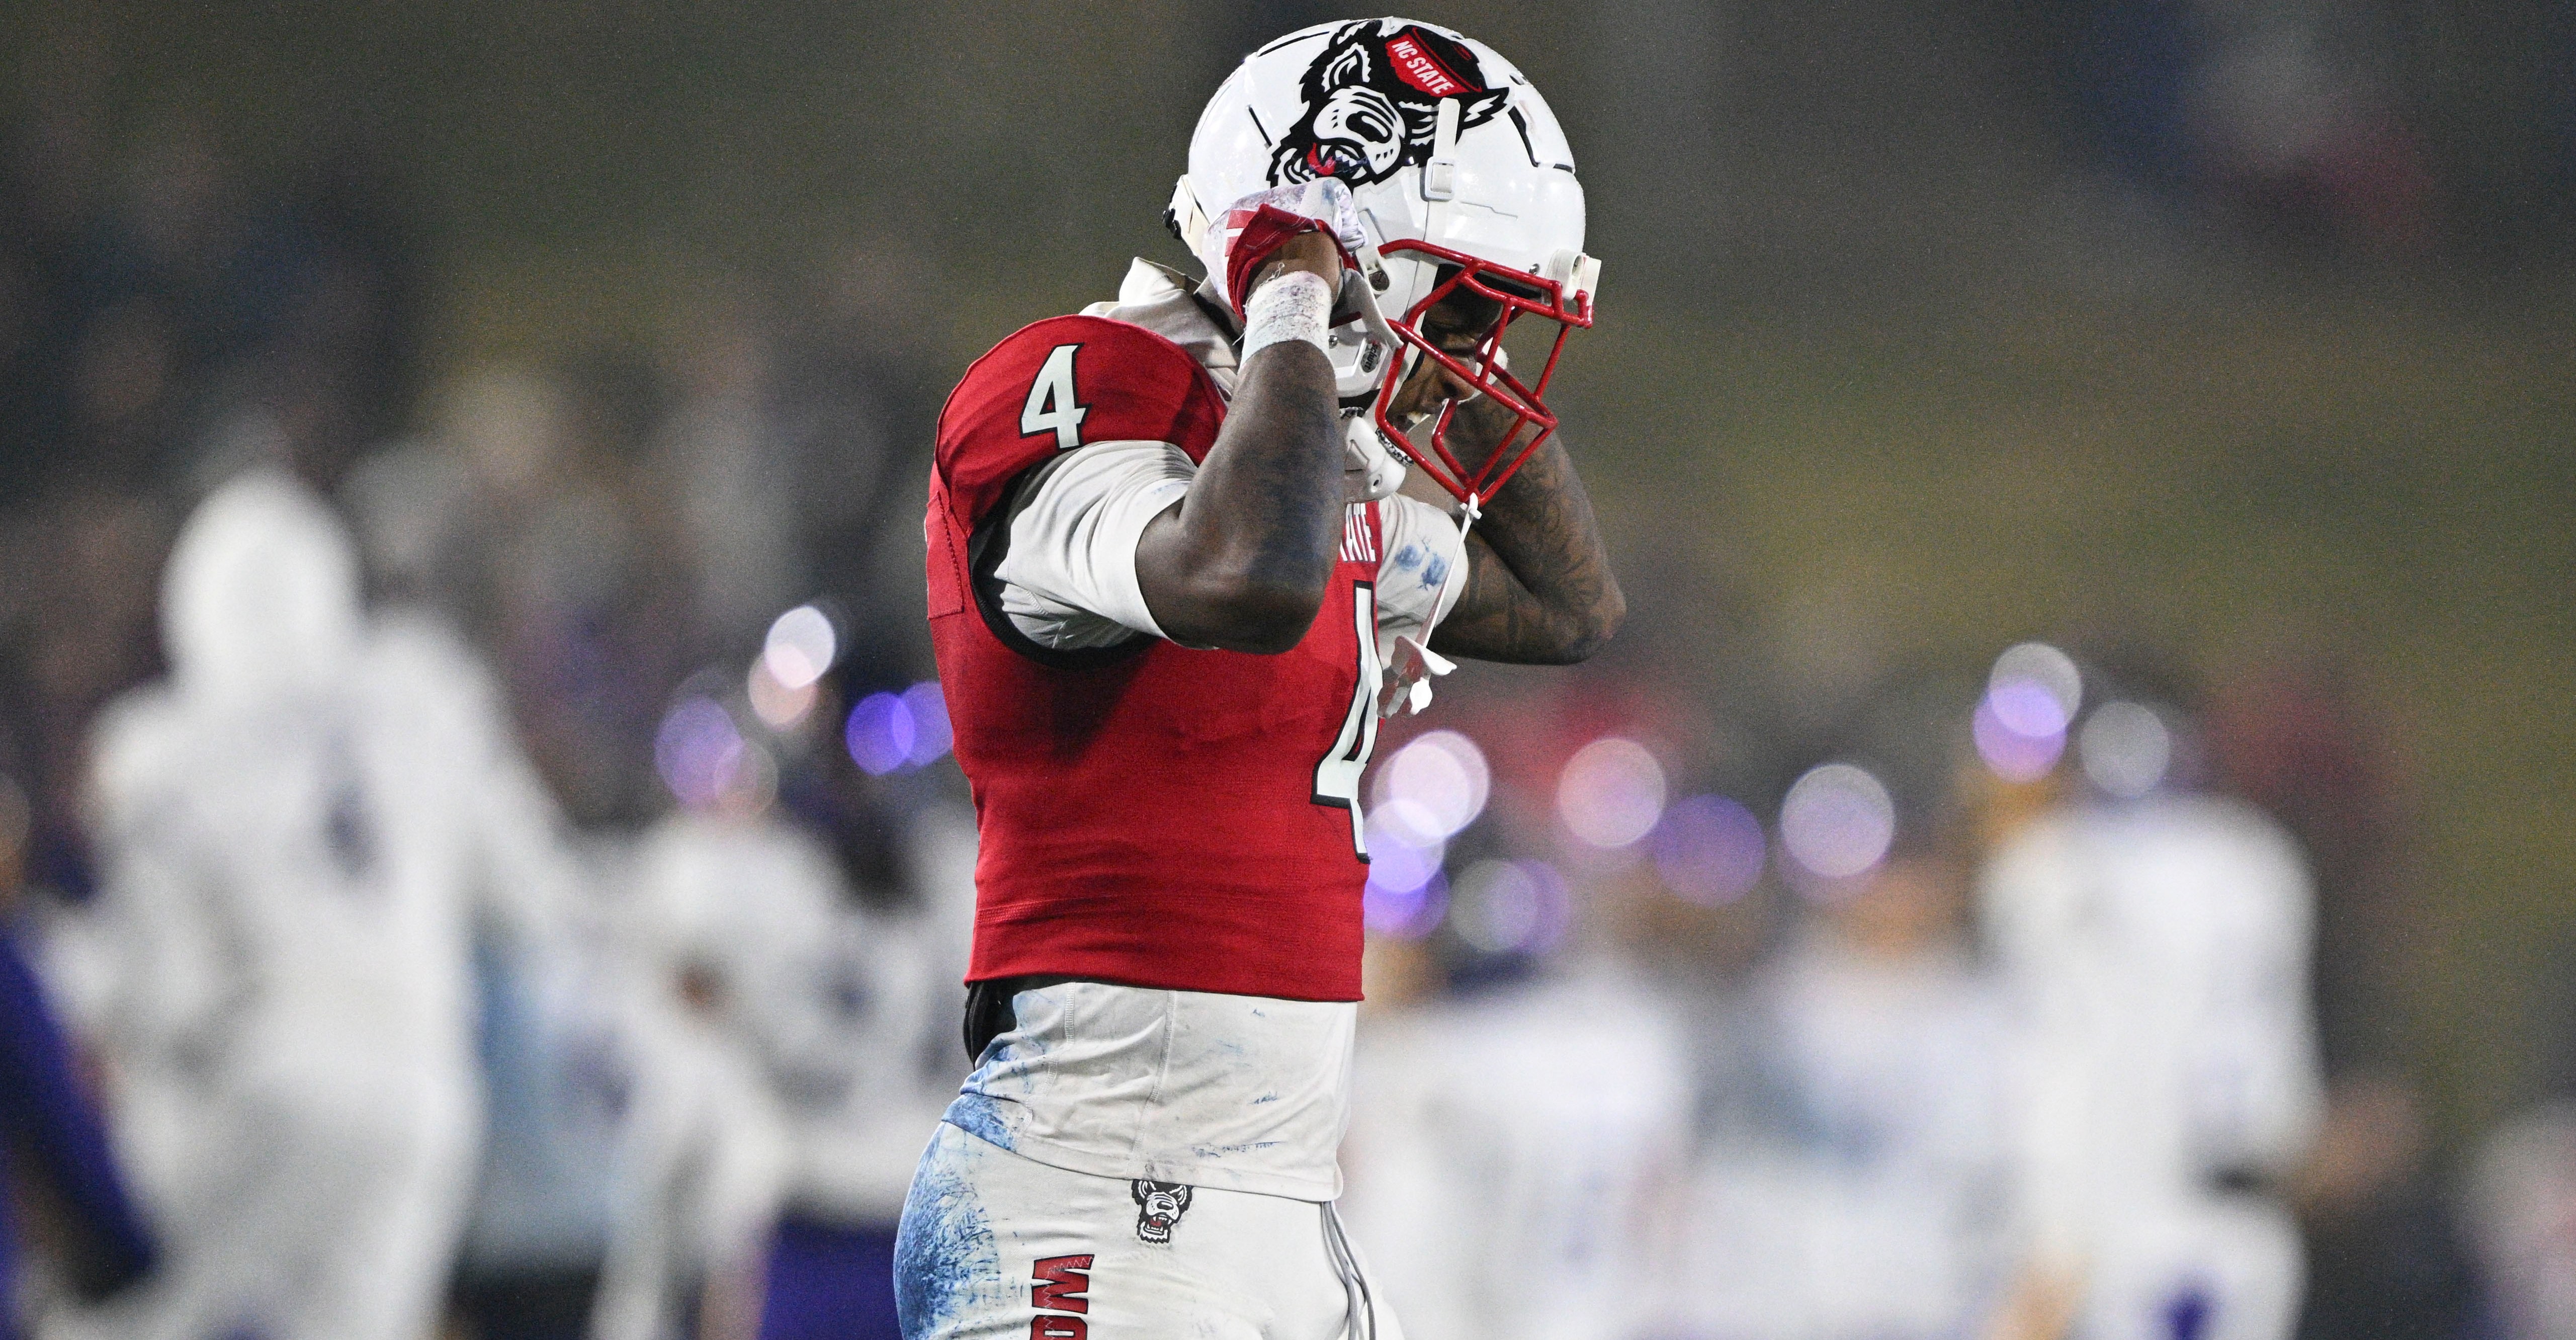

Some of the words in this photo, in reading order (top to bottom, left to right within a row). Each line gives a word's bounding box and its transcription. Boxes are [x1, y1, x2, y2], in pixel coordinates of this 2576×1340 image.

[1392, 40, 1418, 59] NC
[1406, 57, 1455, 95] STATE
[1019, 342, 1093, 449] 4
[1339, 503, 1377, 562] ATE
[1310, 580, 1384, 864] 4
